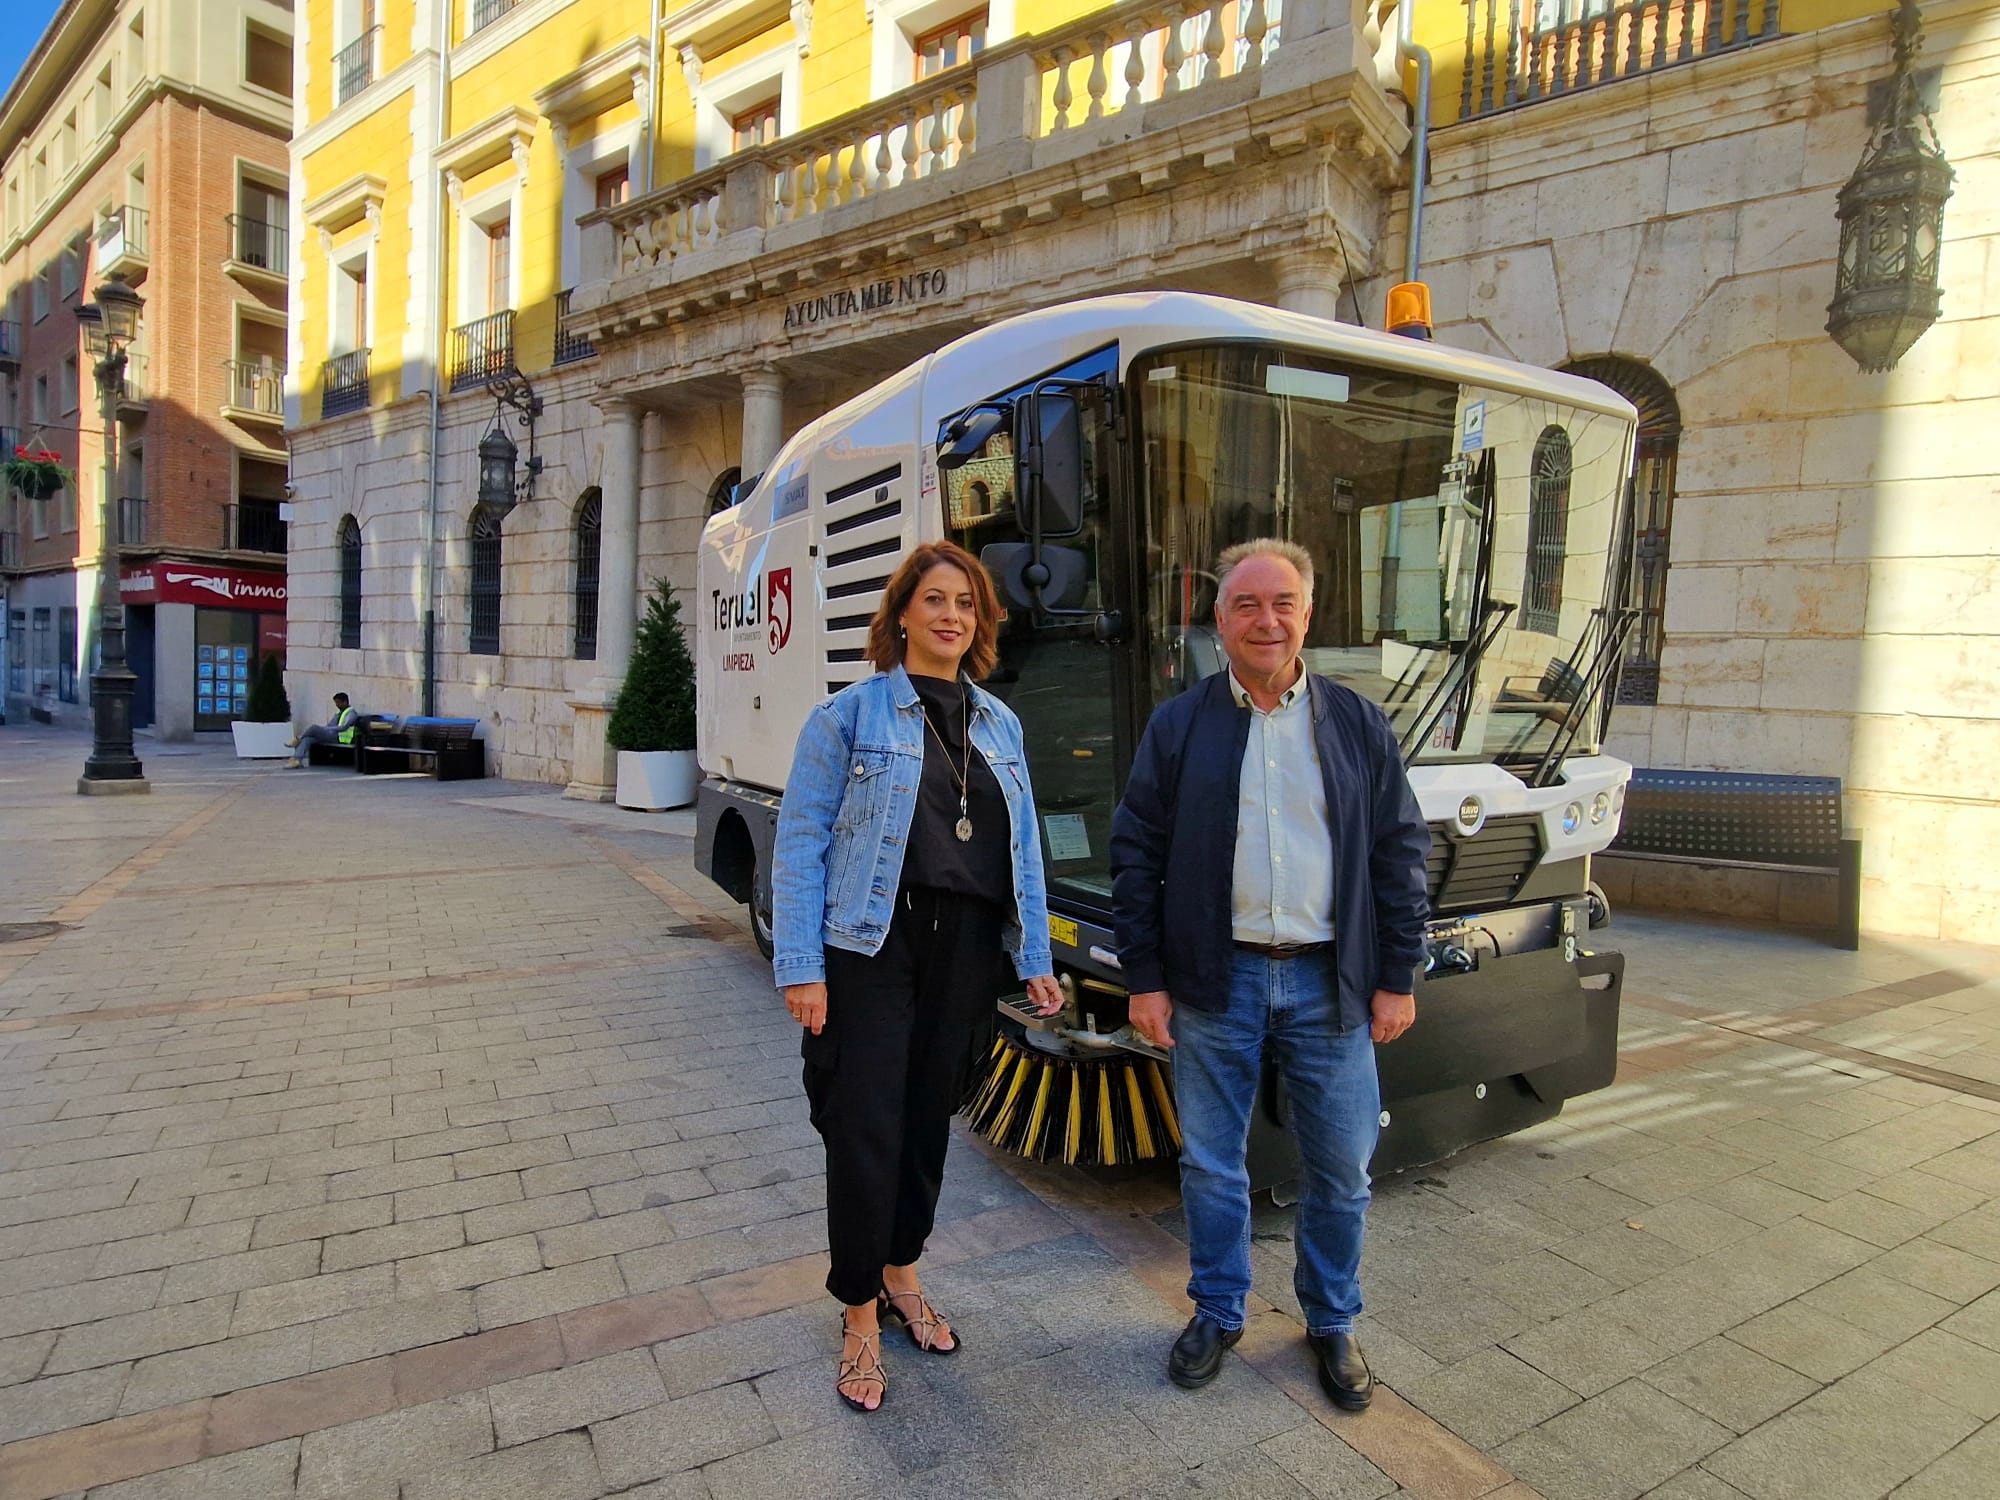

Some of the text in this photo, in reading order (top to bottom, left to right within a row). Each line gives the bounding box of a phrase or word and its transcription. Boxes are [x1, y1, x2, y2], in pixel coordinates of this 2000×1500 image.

[783, 269, 947, 329] AYUNTAMIENTO
[713, 574, 761, 631] Teruel
[722, 653, 755, 671] LIMPIEZA
